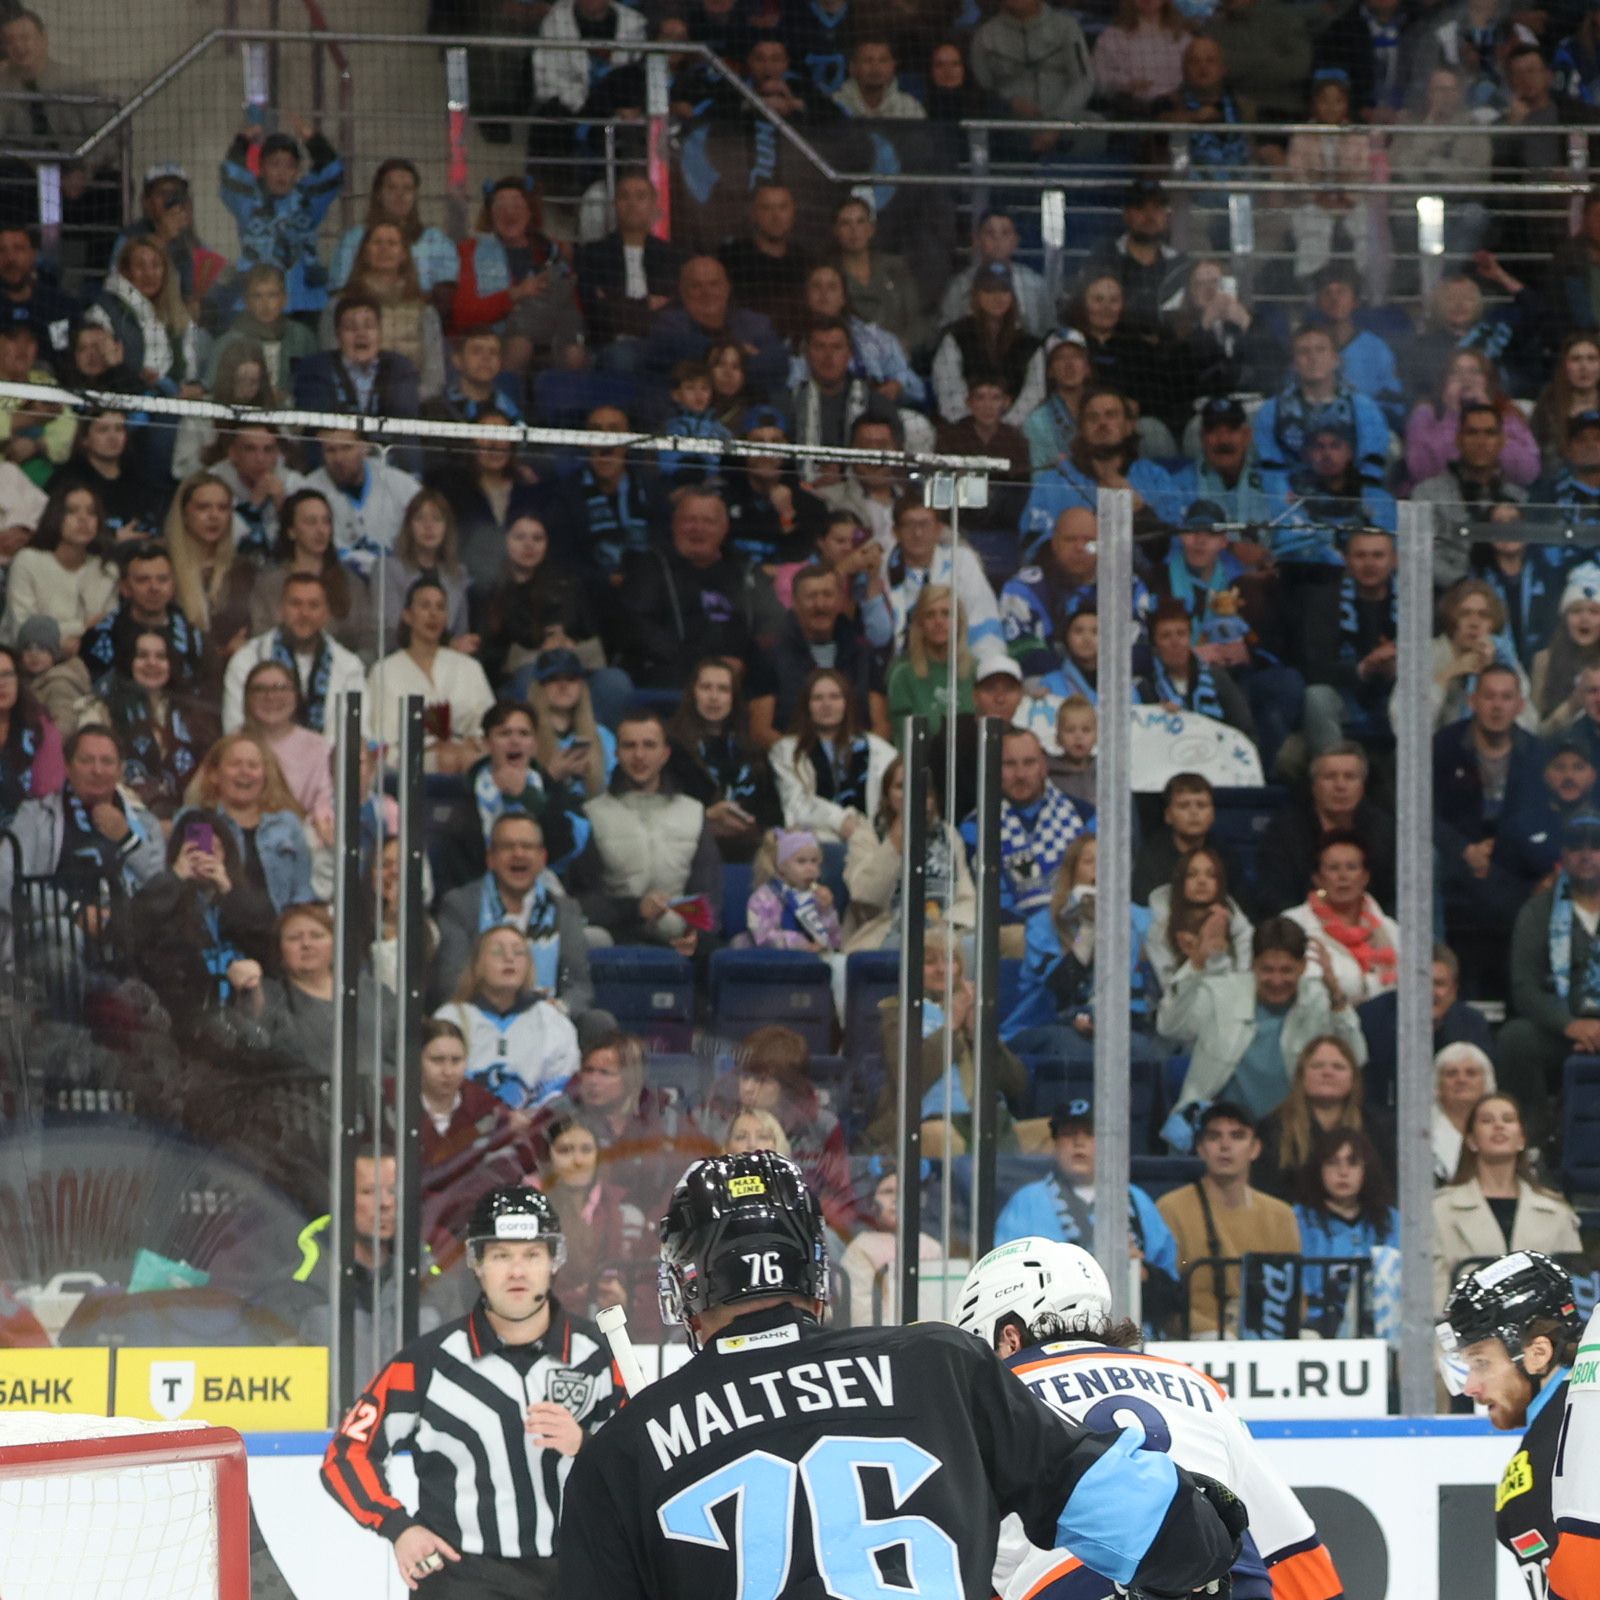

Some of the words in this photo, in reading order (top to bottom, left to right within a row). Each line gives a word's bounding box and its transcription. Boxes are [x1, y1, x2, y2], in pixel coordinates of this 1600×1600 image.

[733, 1177, 758, 1187] MAX
[736, 1185, 760, 1195] LINE
[740, 1250, 784, 1288] 76
[994, 1282, 1025, 1299] CCM
[748, 1330, 790, 1343] БАНК
[203, 1375, 293, 1403] БАНК
[1187, 1360, 1369, 1399] HL.RU
[646, 1355, 894, 1472] MALTSEV
